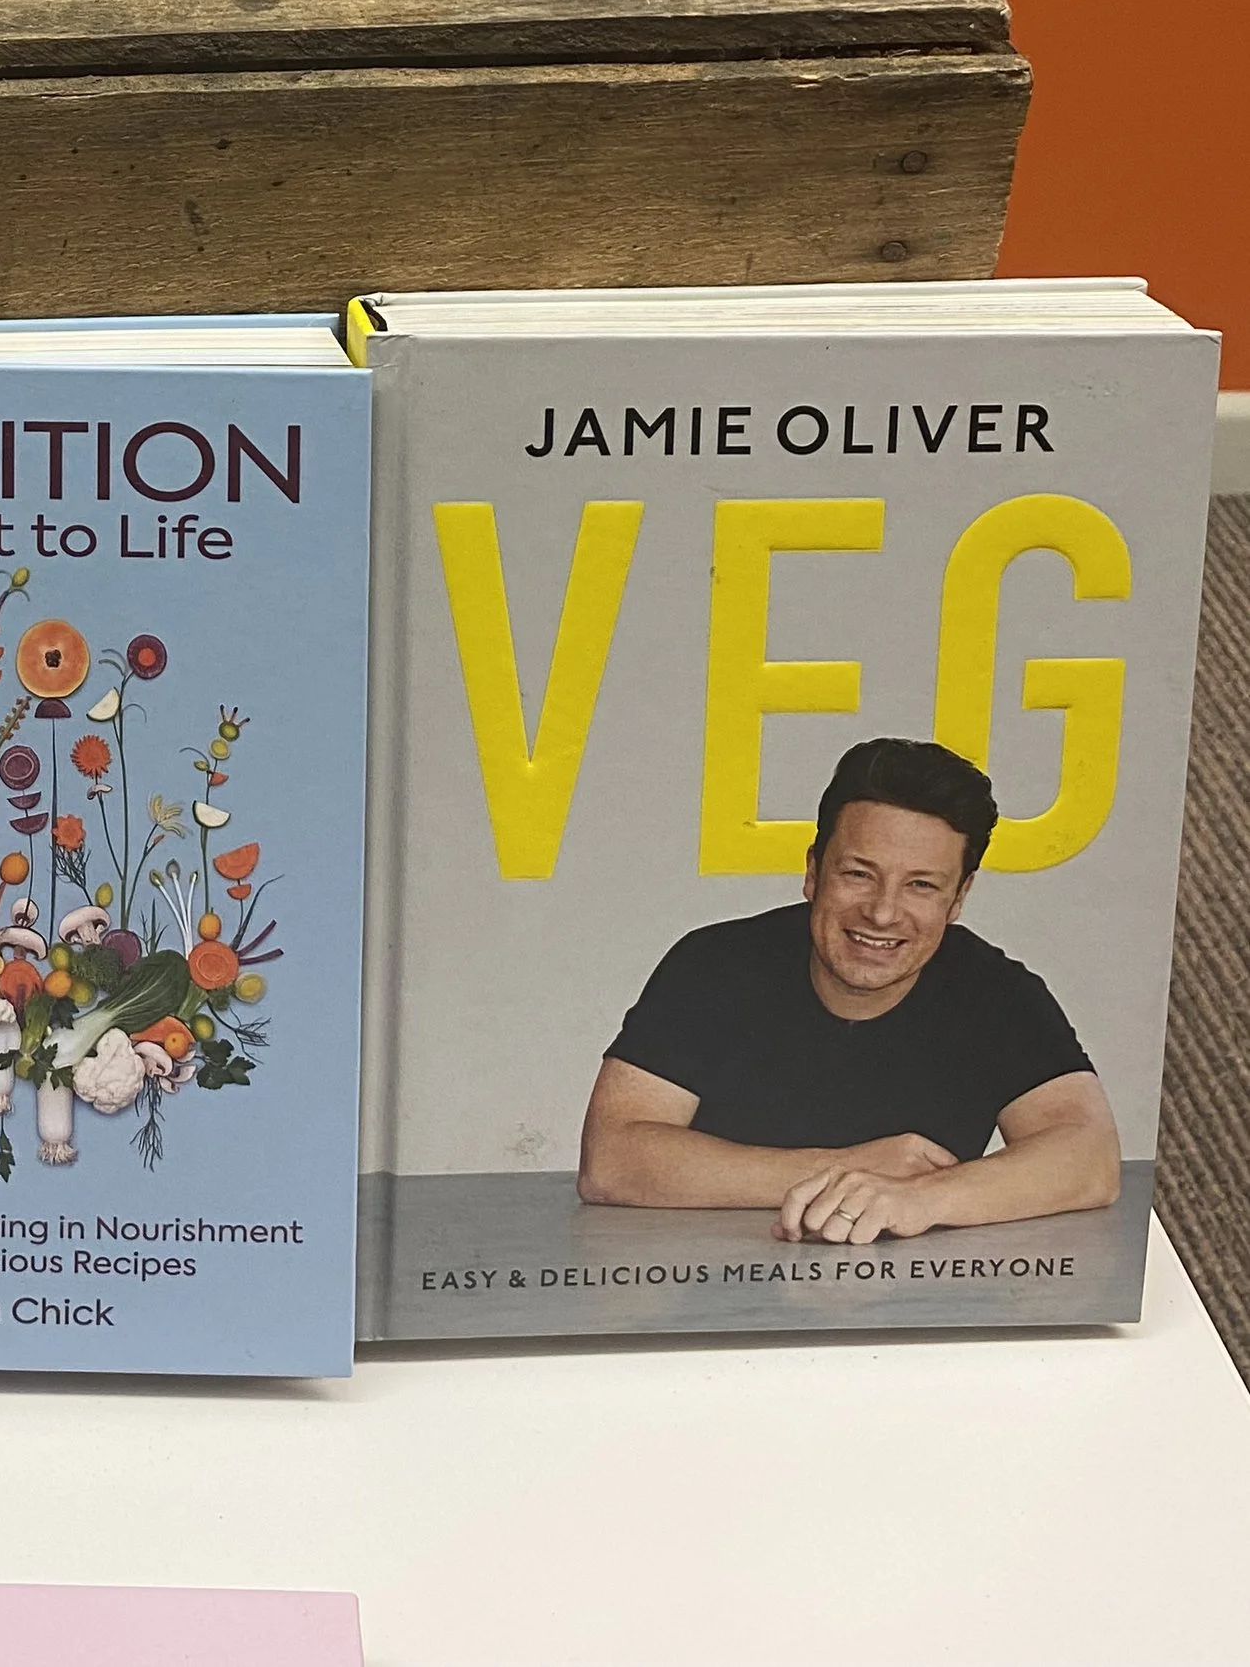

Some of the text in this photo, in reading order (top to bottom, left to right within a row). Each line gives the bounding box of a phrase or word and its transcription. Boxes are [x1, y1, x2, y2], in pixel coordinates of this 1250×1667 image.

[525, 404, 1055, 458] JAMIE OLIVER
[30, 513, 97, 558] to
[120, 514, 234, 560] Life
[432, 493, 1132, 880] VEG
[59, 1214, 86, 1240] in
[96, 1215, 304, 1244] Nourishment
[73, 1250, 198, 1282] Recipes
[422, 1256, 1077, 1291] EASY & DELICIOUS MEALS FOR EVERYONE
[11, 1297, 115, 1327] Chick
